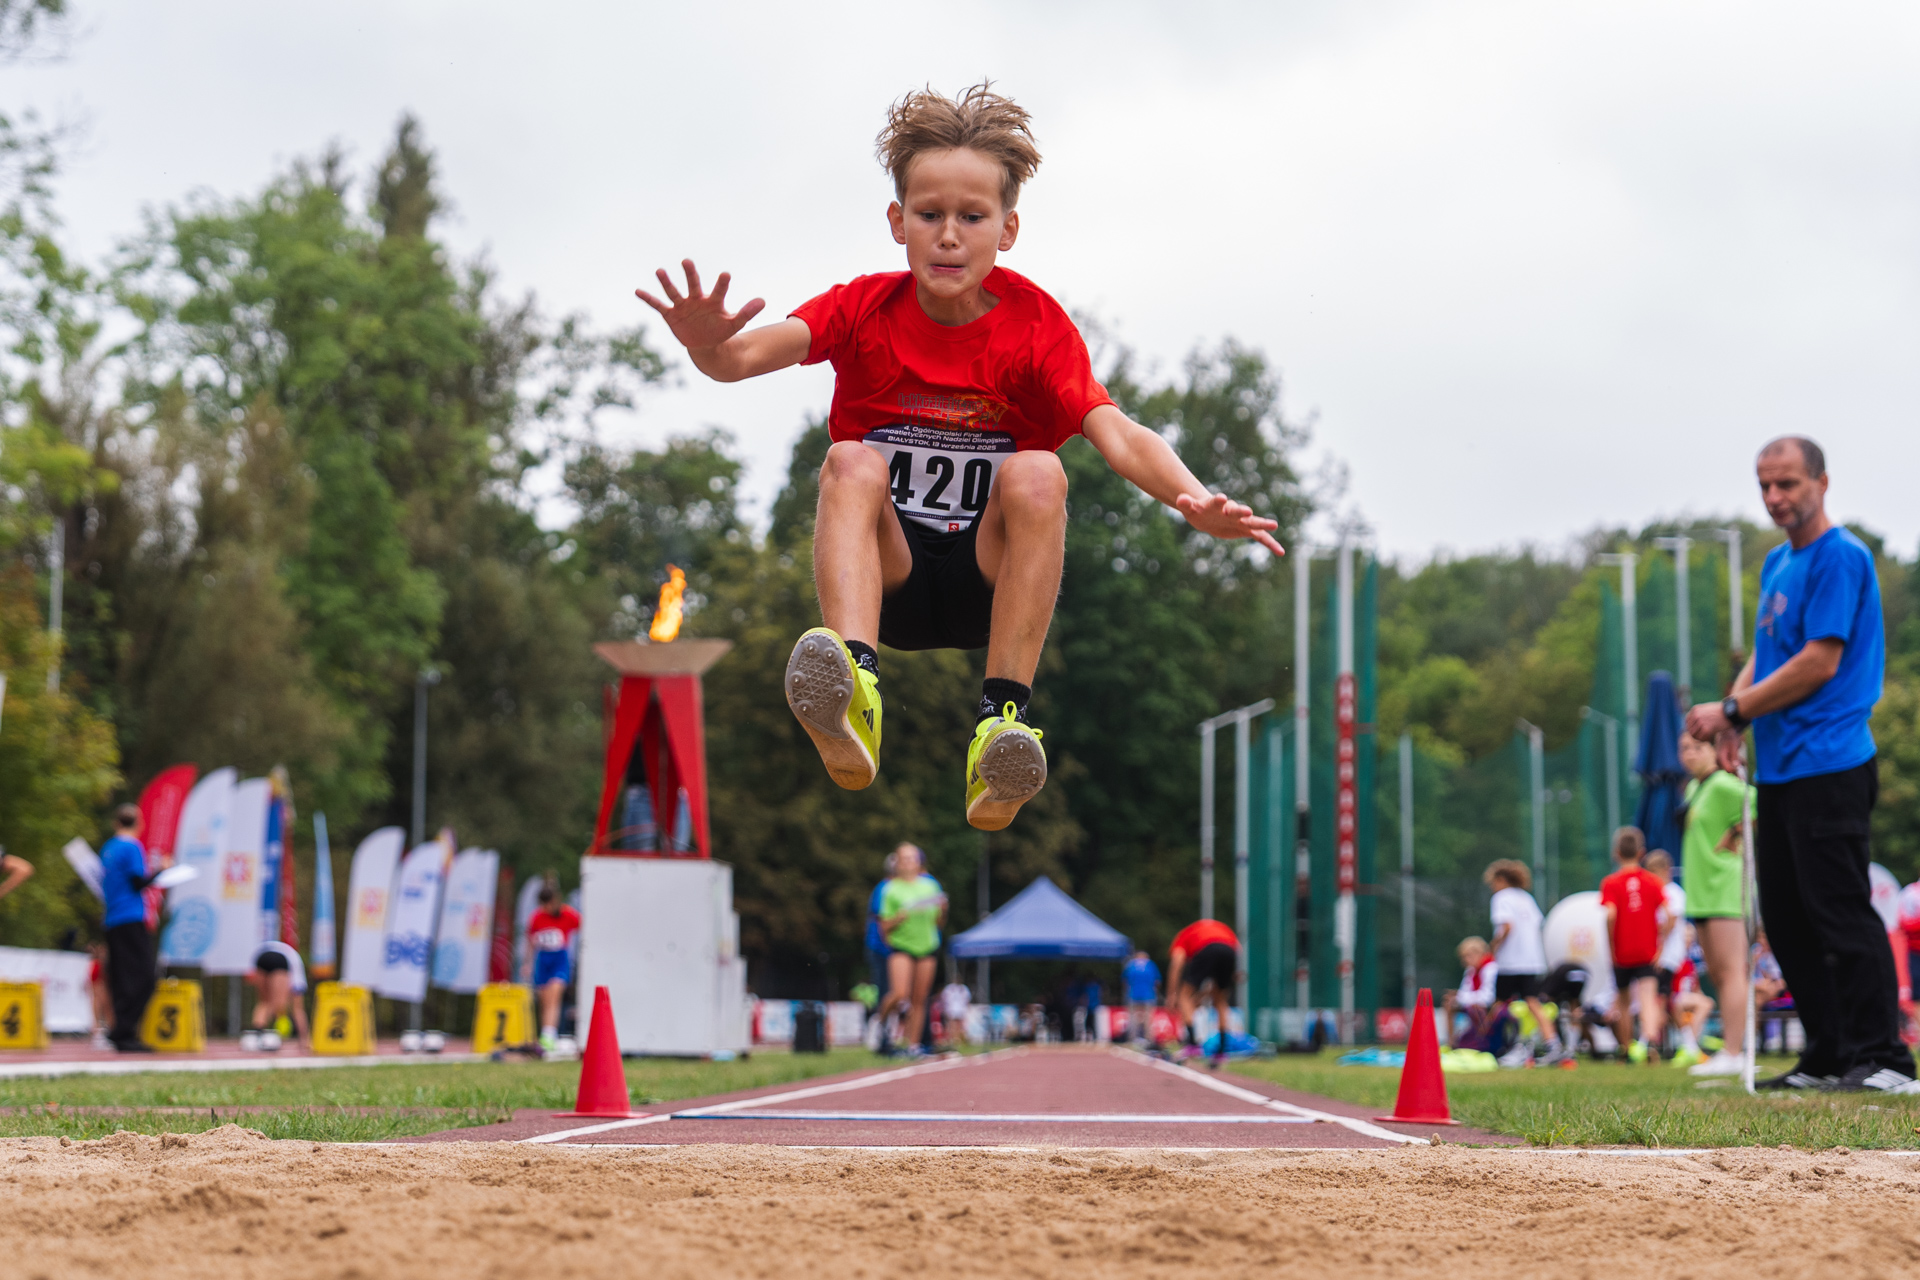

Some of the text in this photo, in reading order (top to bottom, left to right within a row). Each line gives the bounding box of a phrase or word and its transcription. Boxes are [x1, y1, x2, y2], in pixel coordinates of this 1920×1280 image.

[887, 435, 931, 447] BIAŁYSTOK,
[940, 442, 975, 450] września
[912, 426, 962, 437] Ogólnopolski
[889, 450, 992, 512] 420
[2, 1003, 21, 1038] 4
[157, 1005, 179, 1040] 3
[328, 1007, 349, 1039] 2
[494, 1009, 509, 1042] 1
